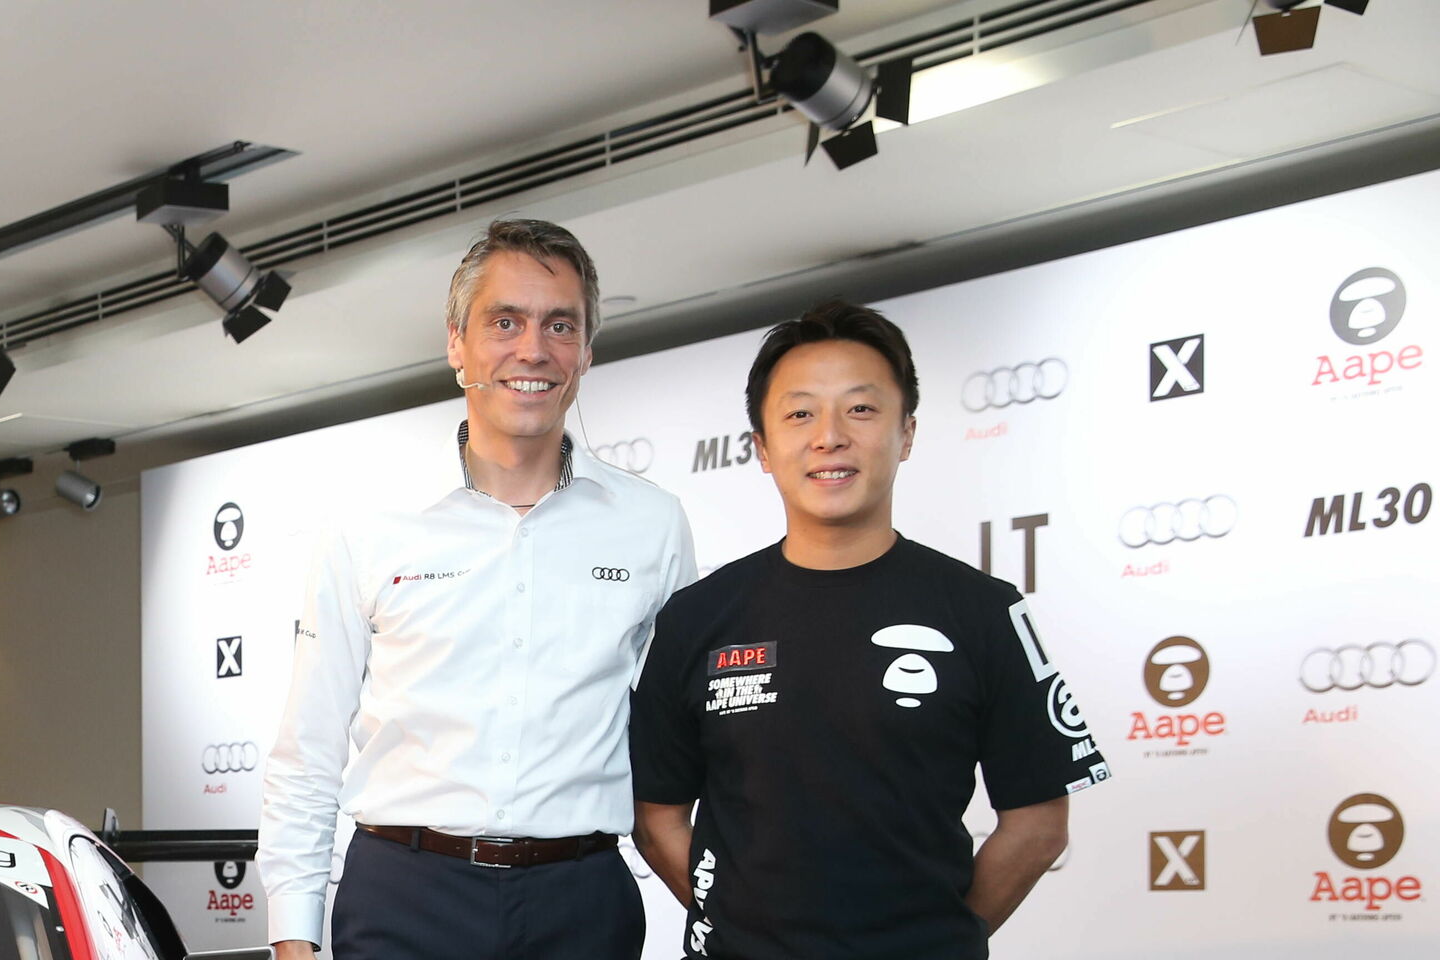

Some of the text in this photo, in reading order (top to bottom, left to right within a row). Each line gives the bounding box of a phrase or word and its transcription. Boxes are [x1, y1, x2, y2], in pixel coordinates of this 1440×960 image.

[1311, 345, 1423, 385] Aape
[964, 422, 1008, 440] Audi
[692, 431, 760, 474] ML3
[1304, 482, 1432, 537] ML30
[980, 513, 1049, 593] IT
[207, 554, 251, 577] Aape
[1121, 560, 1169, 578] Audi
[717, 648, 766, 668] AAPE
[708, 673, 772, 691] SOMEWHERE
[706, 697, 728, 711] AAPE
[728, 692, 778, 708] UNIVERSE
[1302, 706, 1359, 724] Audi
[1127, 711, 1225, 745] Aape
[203, 784, 227, 794] Audi
[1310, 872, 1422, 910] Aape
[207, 890, 254, 916] Aape
